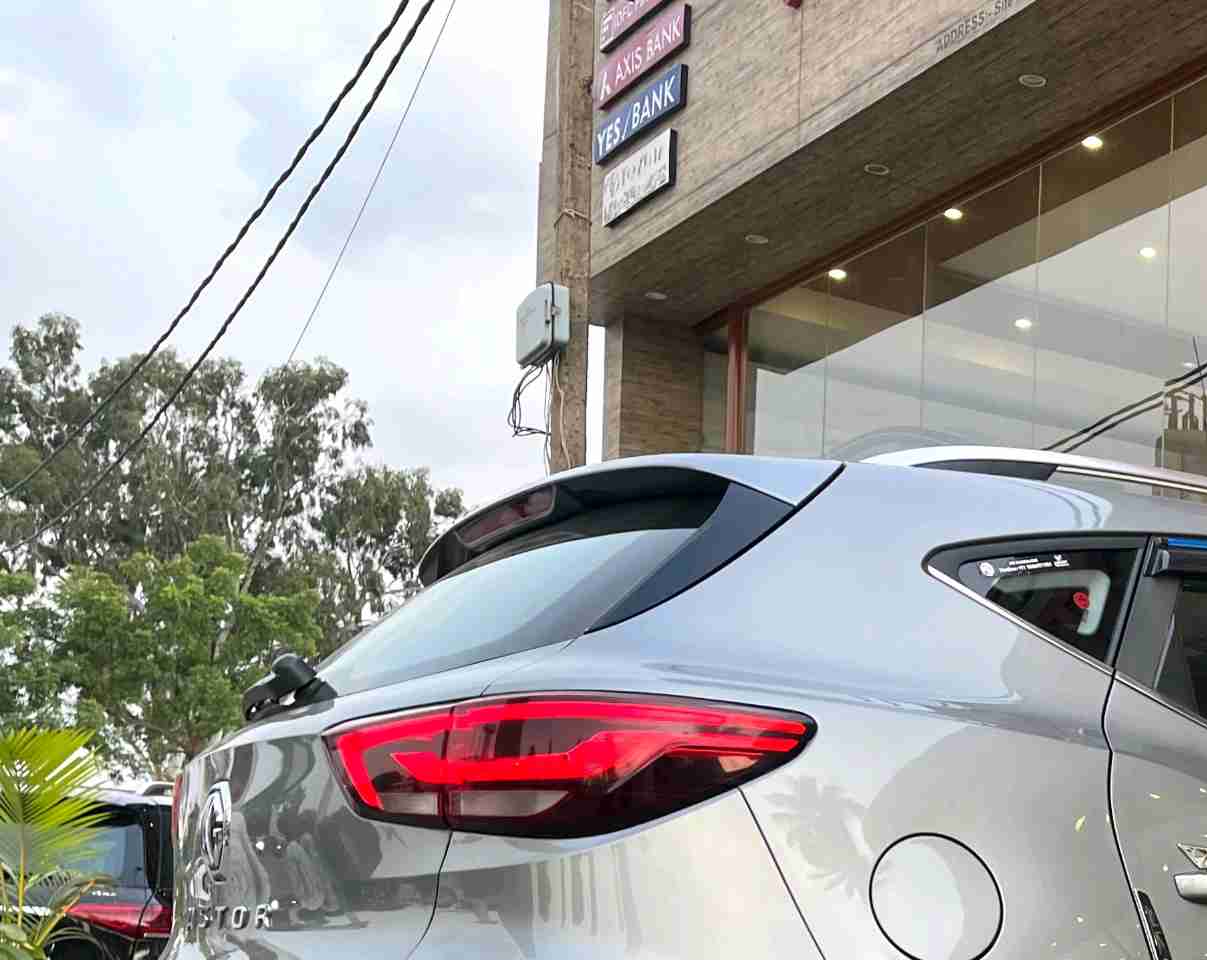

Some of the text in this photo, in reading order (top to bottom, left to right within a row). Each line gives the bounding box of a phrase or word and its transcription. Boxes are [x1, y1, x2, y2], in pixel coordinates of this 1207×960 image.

[615, 15, 681, 86] AXIS BANK
[596, 75, 676, 156] YES BANK
